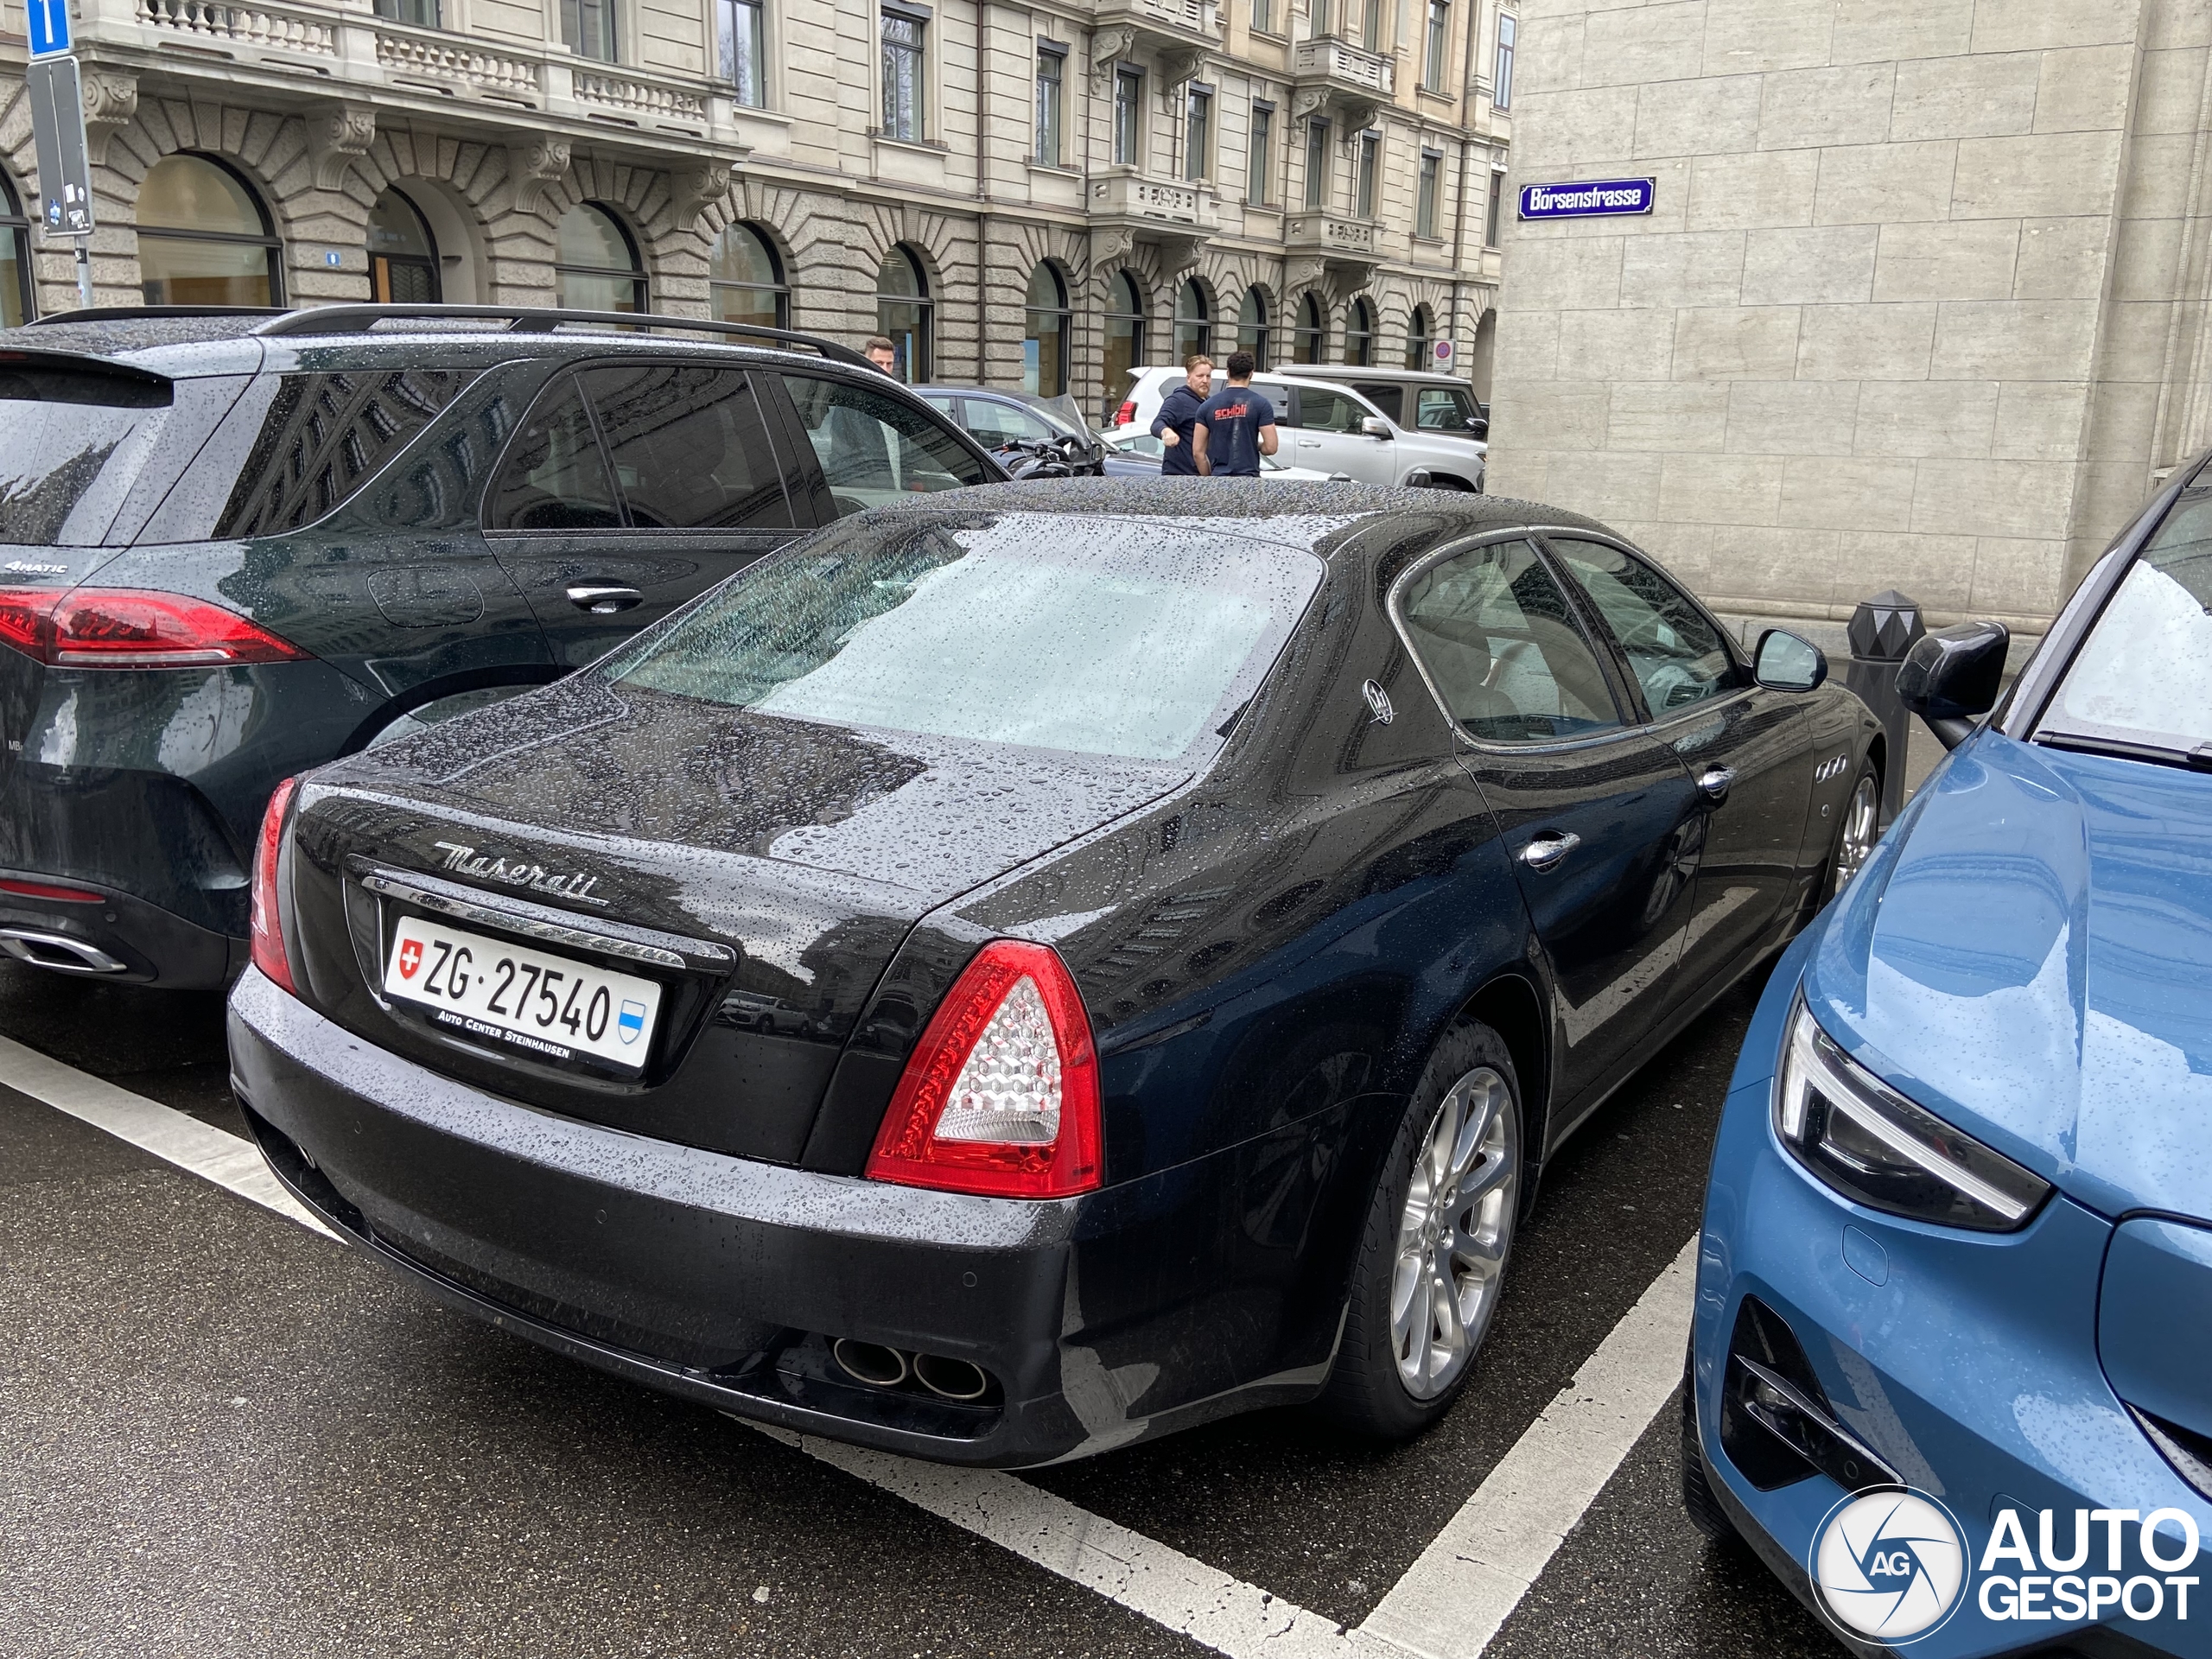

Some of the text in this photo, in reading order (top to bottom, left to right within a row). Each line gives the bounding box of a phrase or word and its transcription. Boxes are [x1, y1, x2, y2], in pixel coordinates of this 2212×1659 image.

[1530, 187, 1641, 210] Börsenstrasse
[4, 560, 68, 574] 4MATIC
[435, 841, 610, 906] Maserati
